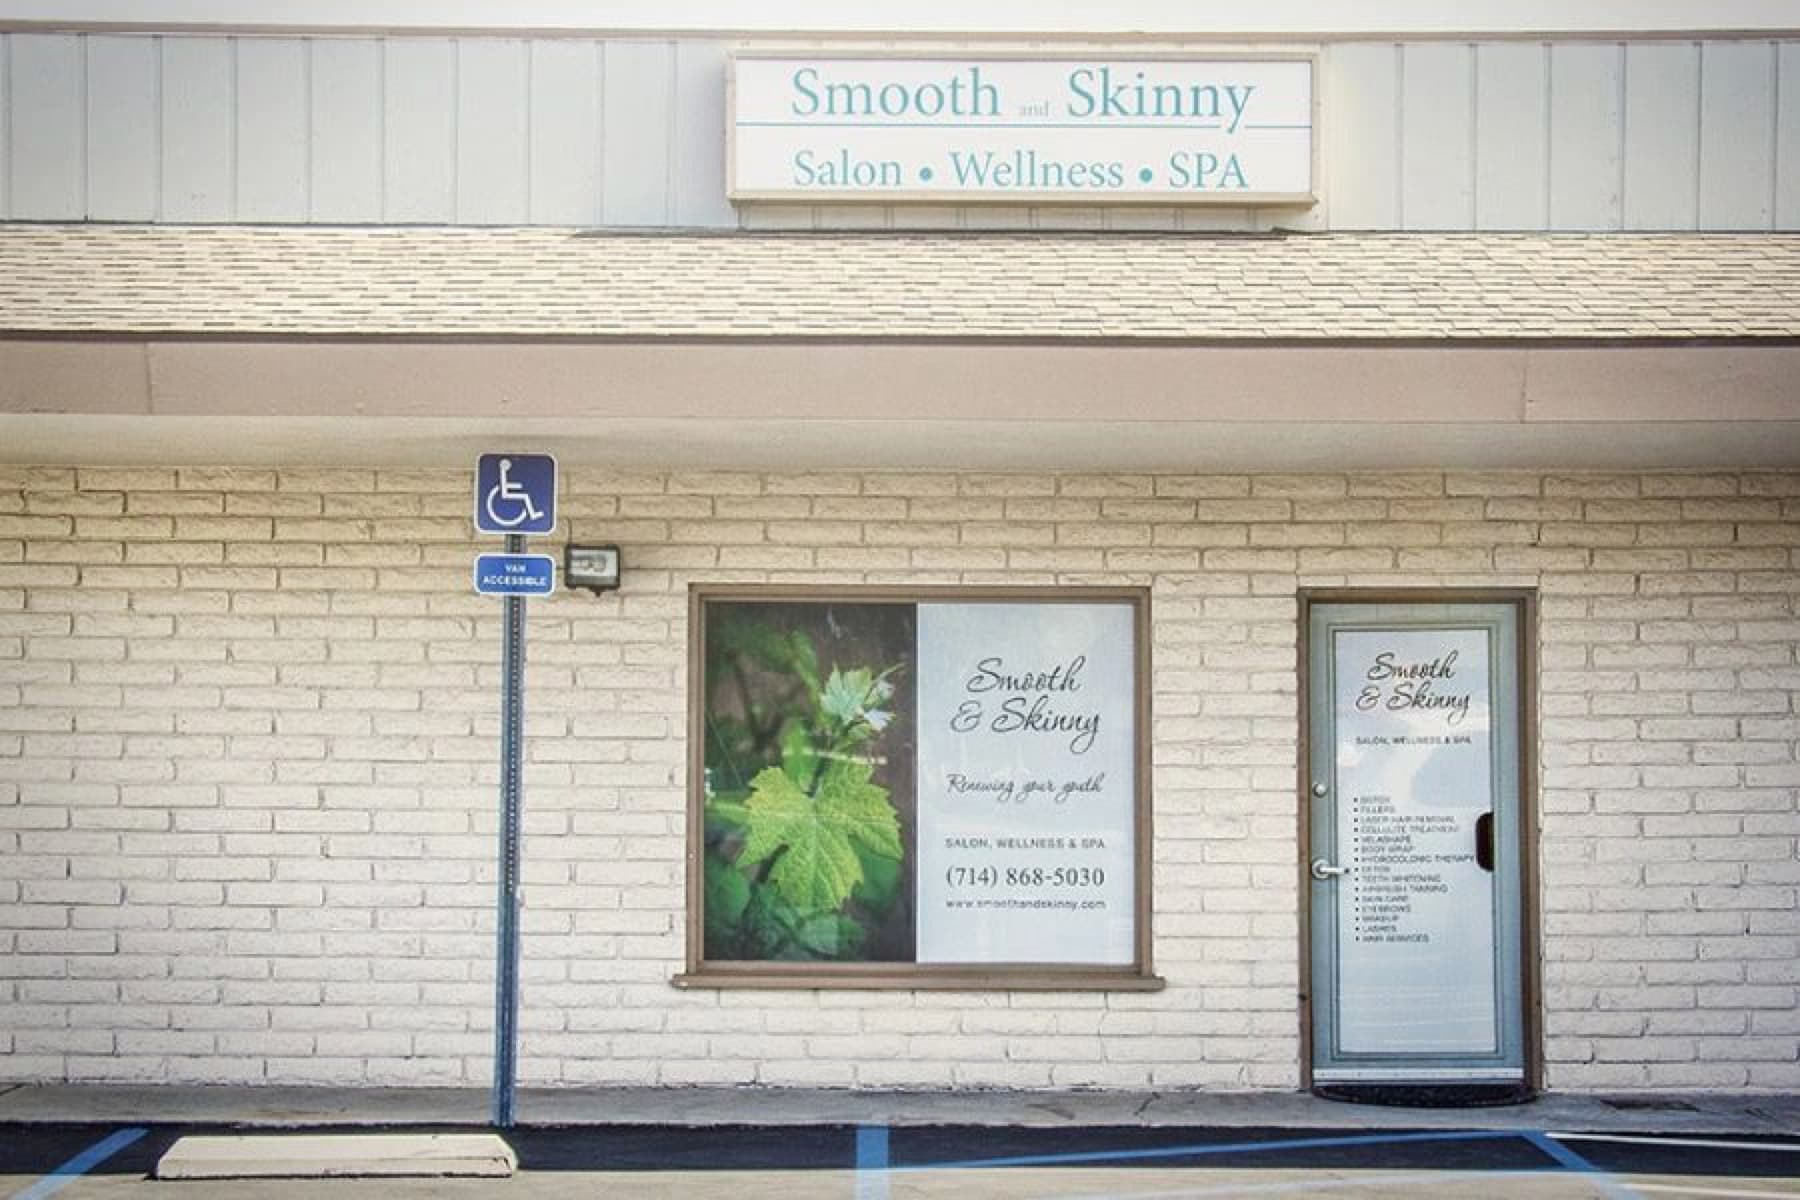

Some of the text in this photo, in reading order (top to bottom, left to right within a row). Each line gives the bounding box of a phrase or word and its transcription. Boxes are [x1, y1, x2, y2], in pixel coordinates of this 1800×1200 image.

[791, 66, 1256, 133] Smooth and Skinny
[793, 148, 1249, 189] Salon Wellness SPA
[482, 575, 548, 587] ACCESSIBLE
[504, 562, 527, 573] VAN
[966, 655, 1086, 693] Smooth
[1367, 649, 1459, 680] Smooth
[1355, 680, 1471, 726] & Skinny
[951, 694, 1101, 754] & Skinny
[946, 772, 1105, 804] Renewing your youth
[945, 838, 1105, 850] SALON, WELLNESS & SPA
[946, 864, 1105, 888] (714) 868-5030
[946, 899, 1107, 912] www.smoothandskinny.com
